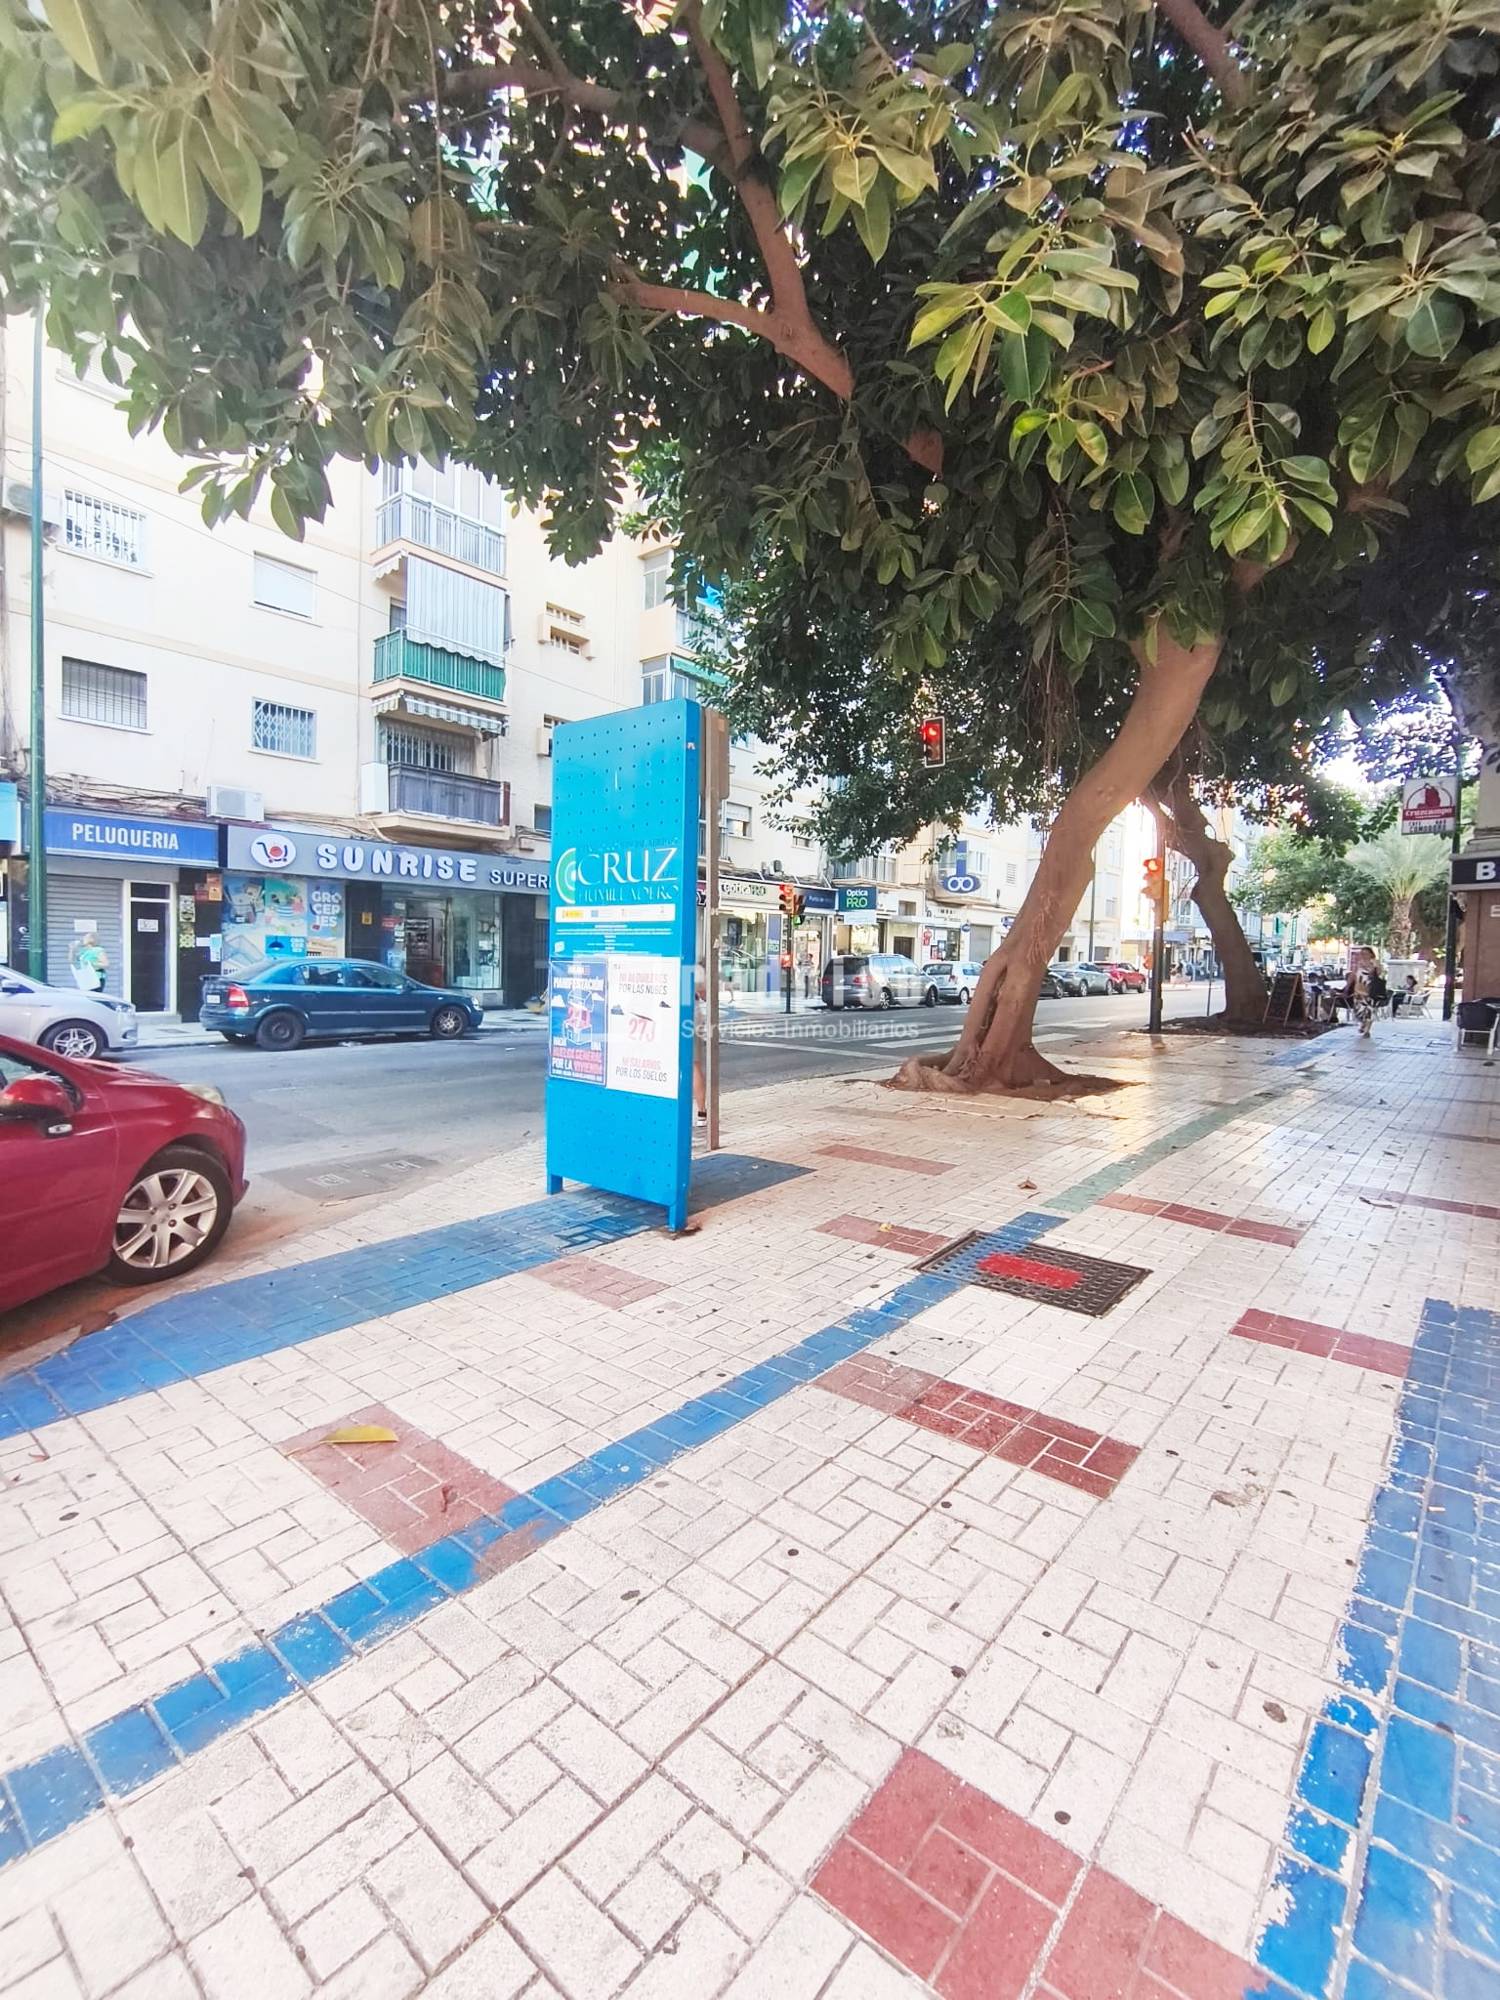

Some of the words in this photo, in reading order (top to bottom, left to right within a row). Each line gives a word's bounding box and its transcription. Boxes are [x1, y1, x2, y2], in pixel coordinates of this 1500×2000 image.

[1405, 807, 1452, 816] Cruzcampo
[72, 822, 179, 851] PELUQUERIA
[316, 843, 477, 882] SUNRISE
[577, 847, 678, 886] CRUZ
[846, 897, 868, 908] PRO
